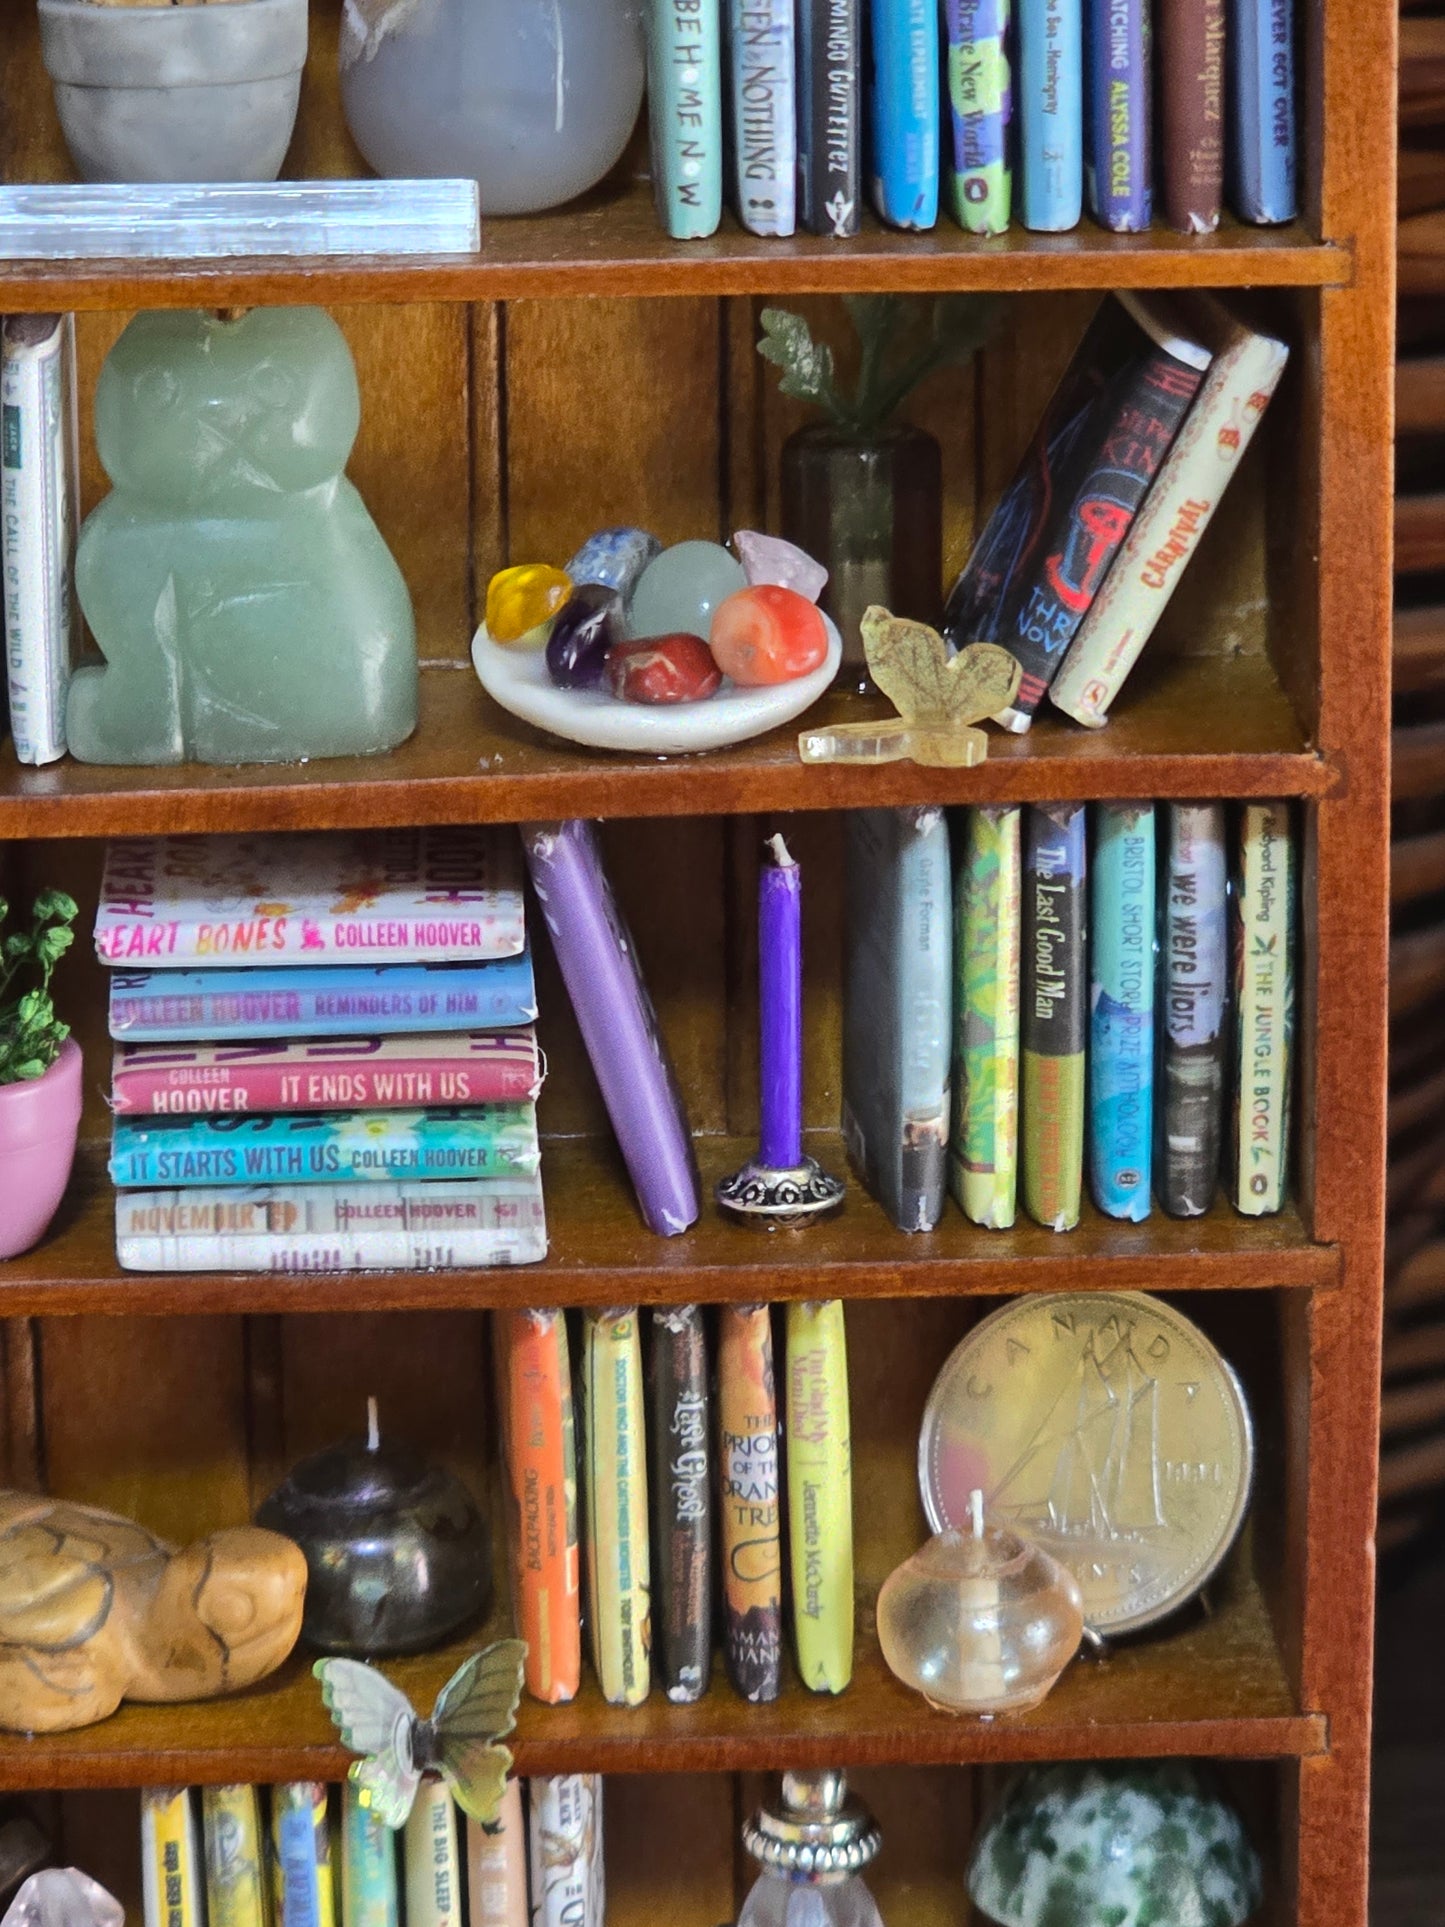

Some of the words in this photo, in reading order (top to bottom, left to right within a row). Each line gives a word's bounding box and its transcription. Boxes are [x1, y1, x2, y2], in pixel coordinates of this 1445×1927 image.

[958, 0, 979, 56] Brave
[959, 60, 983, 103] New
[1270, 52, 1288, 90] GOT
[741, 63, 787, 181] NOTHING
[1110, 79, 1130, 147] ALYSSA
[1270, 96, 1290, 148] OVER
[962, 109, 987, 170] World
[1111, 149, 1132, 198] COLE
[5, 478, 16, 507] THE
[6, 514, 19, 557] CALL
[1139, 498, 1210, 591] CARNIVAL
[7, 566, 18, 585] OF
[8, 592, 20, 621] THE
[9, 628, 22, 669] WILD
[1036, 846, 1066, 881] The
[1121, 836, 1145, 897] BRISTOL
[1035, 882, 1066, 924] Last
[1172, 873, 1198, 906] we
[1256, 876, 1277, 922] Kipling
[196, 917, 288, 955] BONES
[335, 923, 408, 947] COLLEEN
[415, 923, 481, 946] HOOVER
[919, 901, 934, 952] Forman
[1122, 904, 1145, 953] SHORT
[1171, 914, 1198, 974] were
[1034, 928, 1066, 975] Good
[1034, 979, 1066, 1019] Man
[1255, 962, 1275, 997] THE
[212, 990, 300, 1023] HOOVER
[314, 991, 413, 1017] REMINDERS
[419, 992, 438, 1014] OF
[446, 990, 478, 1013] HIM
[1171, 981, 1211, 1034] liars
[1118, 1015, 1143, 1055] PRIZE
[1253, 1005, 1273, 1078] JUNGLE
[168, 1067, 230, 1086] COLLEEN
[280, 1075, 301, 1104] IT
[308, 1072, 367, 1102] ENDS
[373, 1071, 433, 1101] WITH
[440, 1070, 471, 1099] US
[152, 1086, 249, 1113] HOOVER
[1251, 1086, 1271, 1140] BOOK
[130, 1152, 149, 1180] IT
[158, 1148, 237, 1179] STARTS
[244, 1146, 301, 1175] WITH
[310, 1143, 340, 1172] US
[352, 1149, 418, 1168] COLLEEN
[425, 1148, 487, 1167] HOOVER
[335, 1204, 405, 1218] COLLEEN
[410, 1204, 476, 1218] HOOVER
[669, 1397, 706, 1446] Last
[670, 1450, 707, 1521] Ghost
[733, 1460, 753, 1474] OF
[432, 1802, 447, 1832] THE
[433, 1837, 448, 1865] BIG
[434, 1872, 450, 1914] SLEEP
